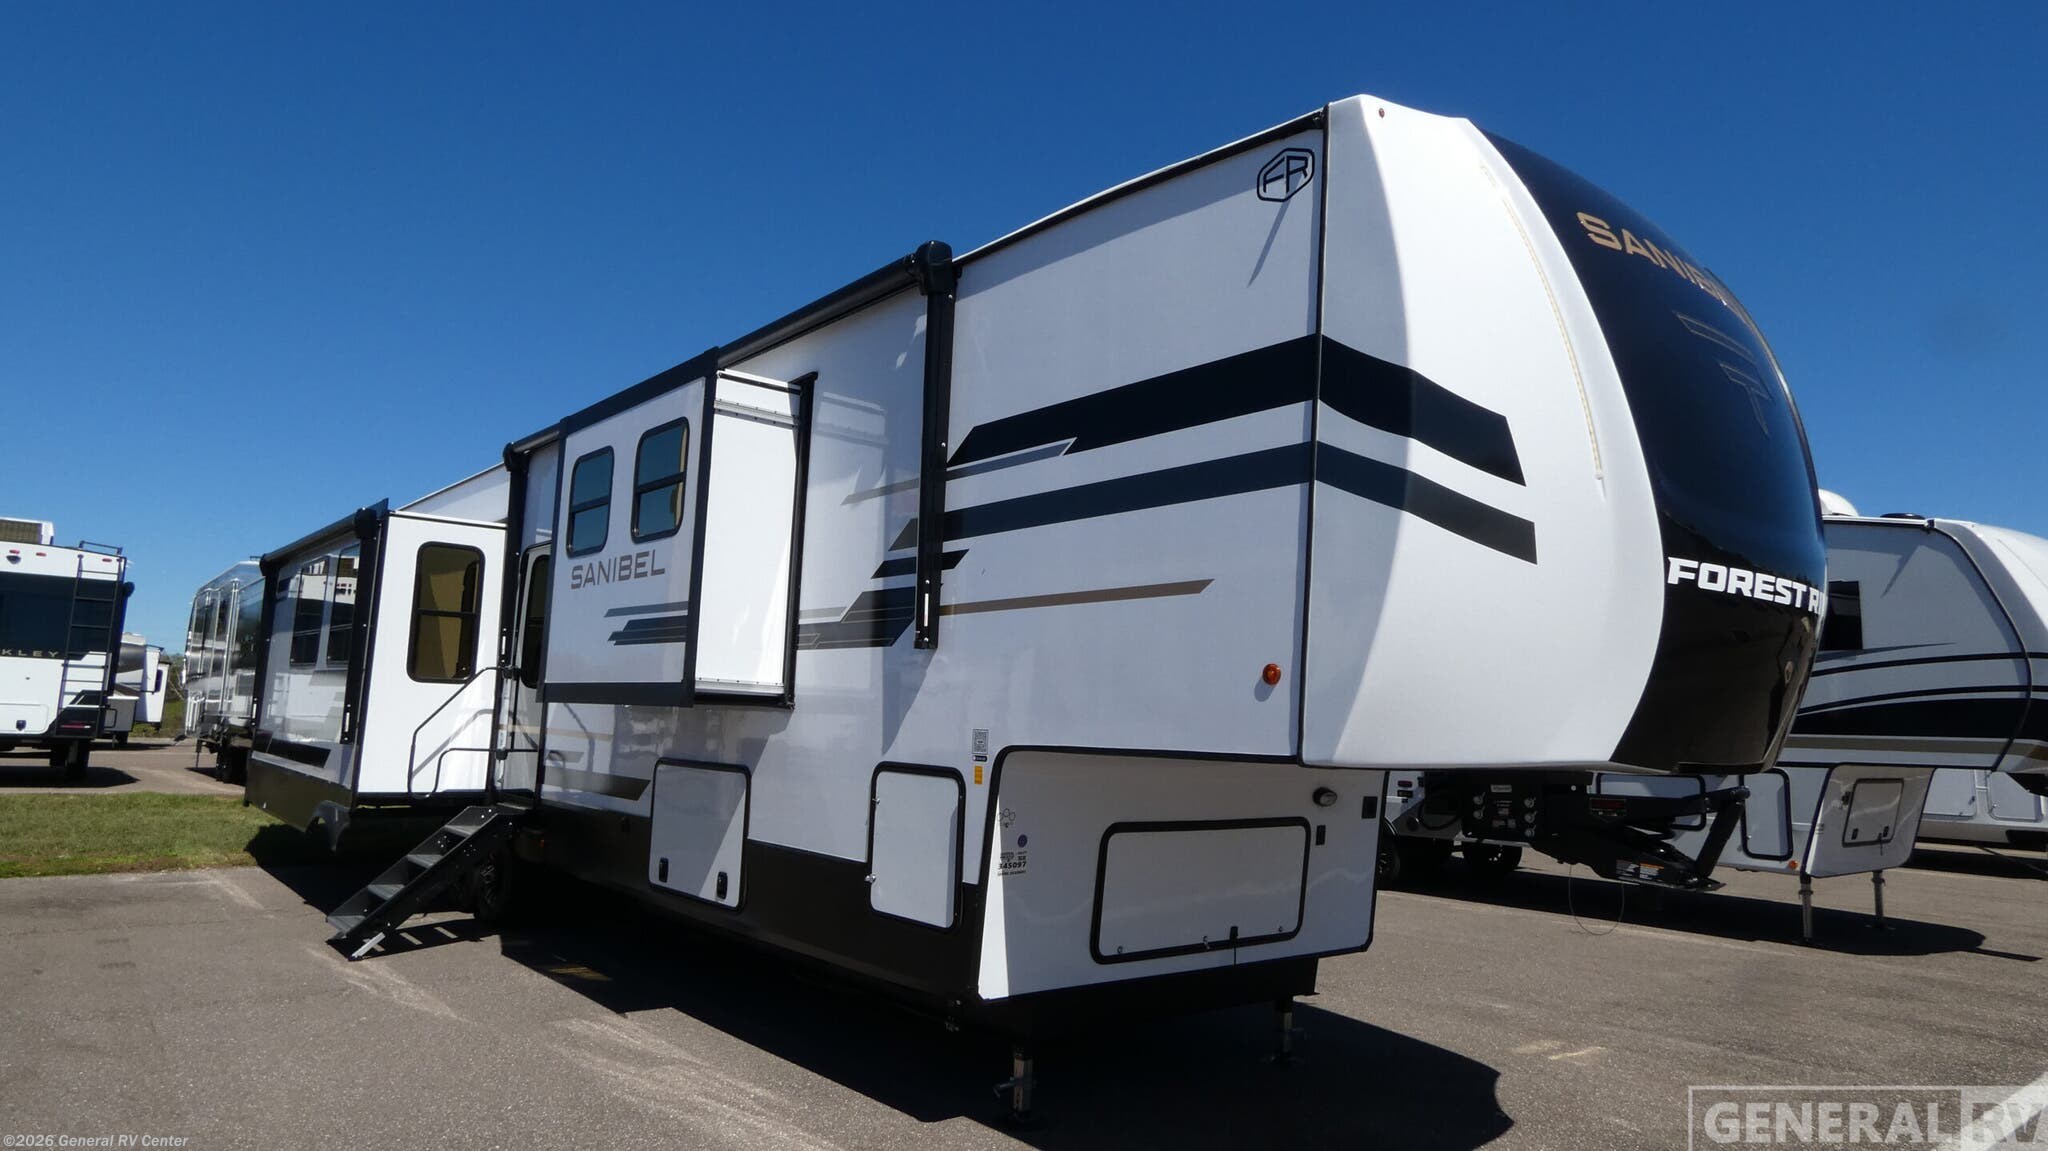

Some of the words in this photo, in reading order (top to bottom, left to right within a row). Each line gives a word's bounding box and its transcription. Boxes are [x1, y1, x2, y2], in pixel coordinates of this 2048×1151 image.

[1576, 211, 1748, 320] SANIB
[571, 548, 665, 590] SANIBEL
[1667, 556, 1807, 608] FOREST
